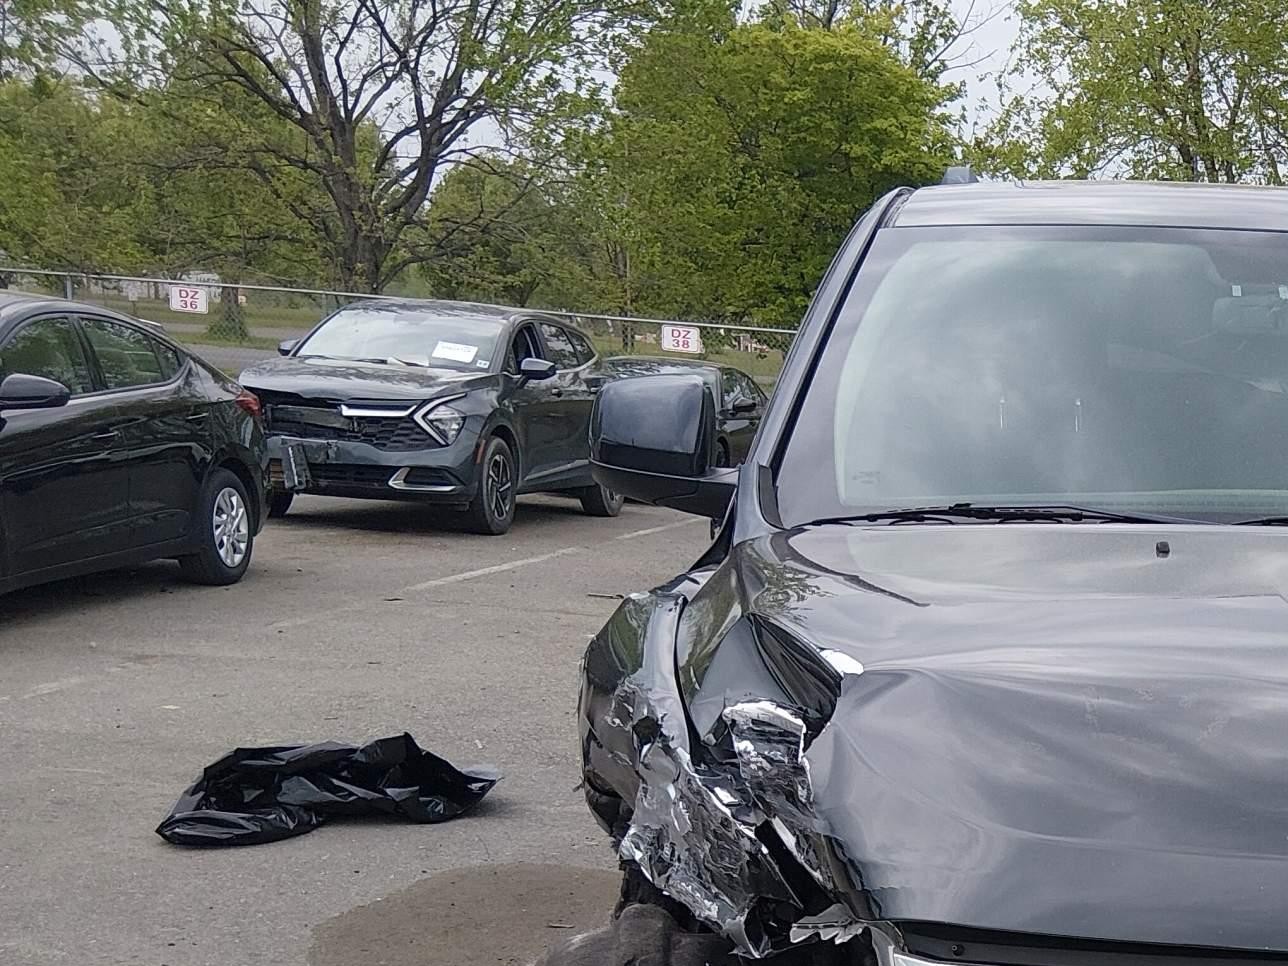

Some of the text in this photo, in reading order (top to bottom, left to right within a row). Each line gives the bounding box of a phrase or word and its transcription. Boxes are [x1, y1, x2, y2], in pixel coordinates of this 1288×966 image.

[178, 289, 200, 300] DZ
[180, 299, 198, 310] 36
[671, 328, 692, 340] DZ
[672, 338, 690, 349] 38
